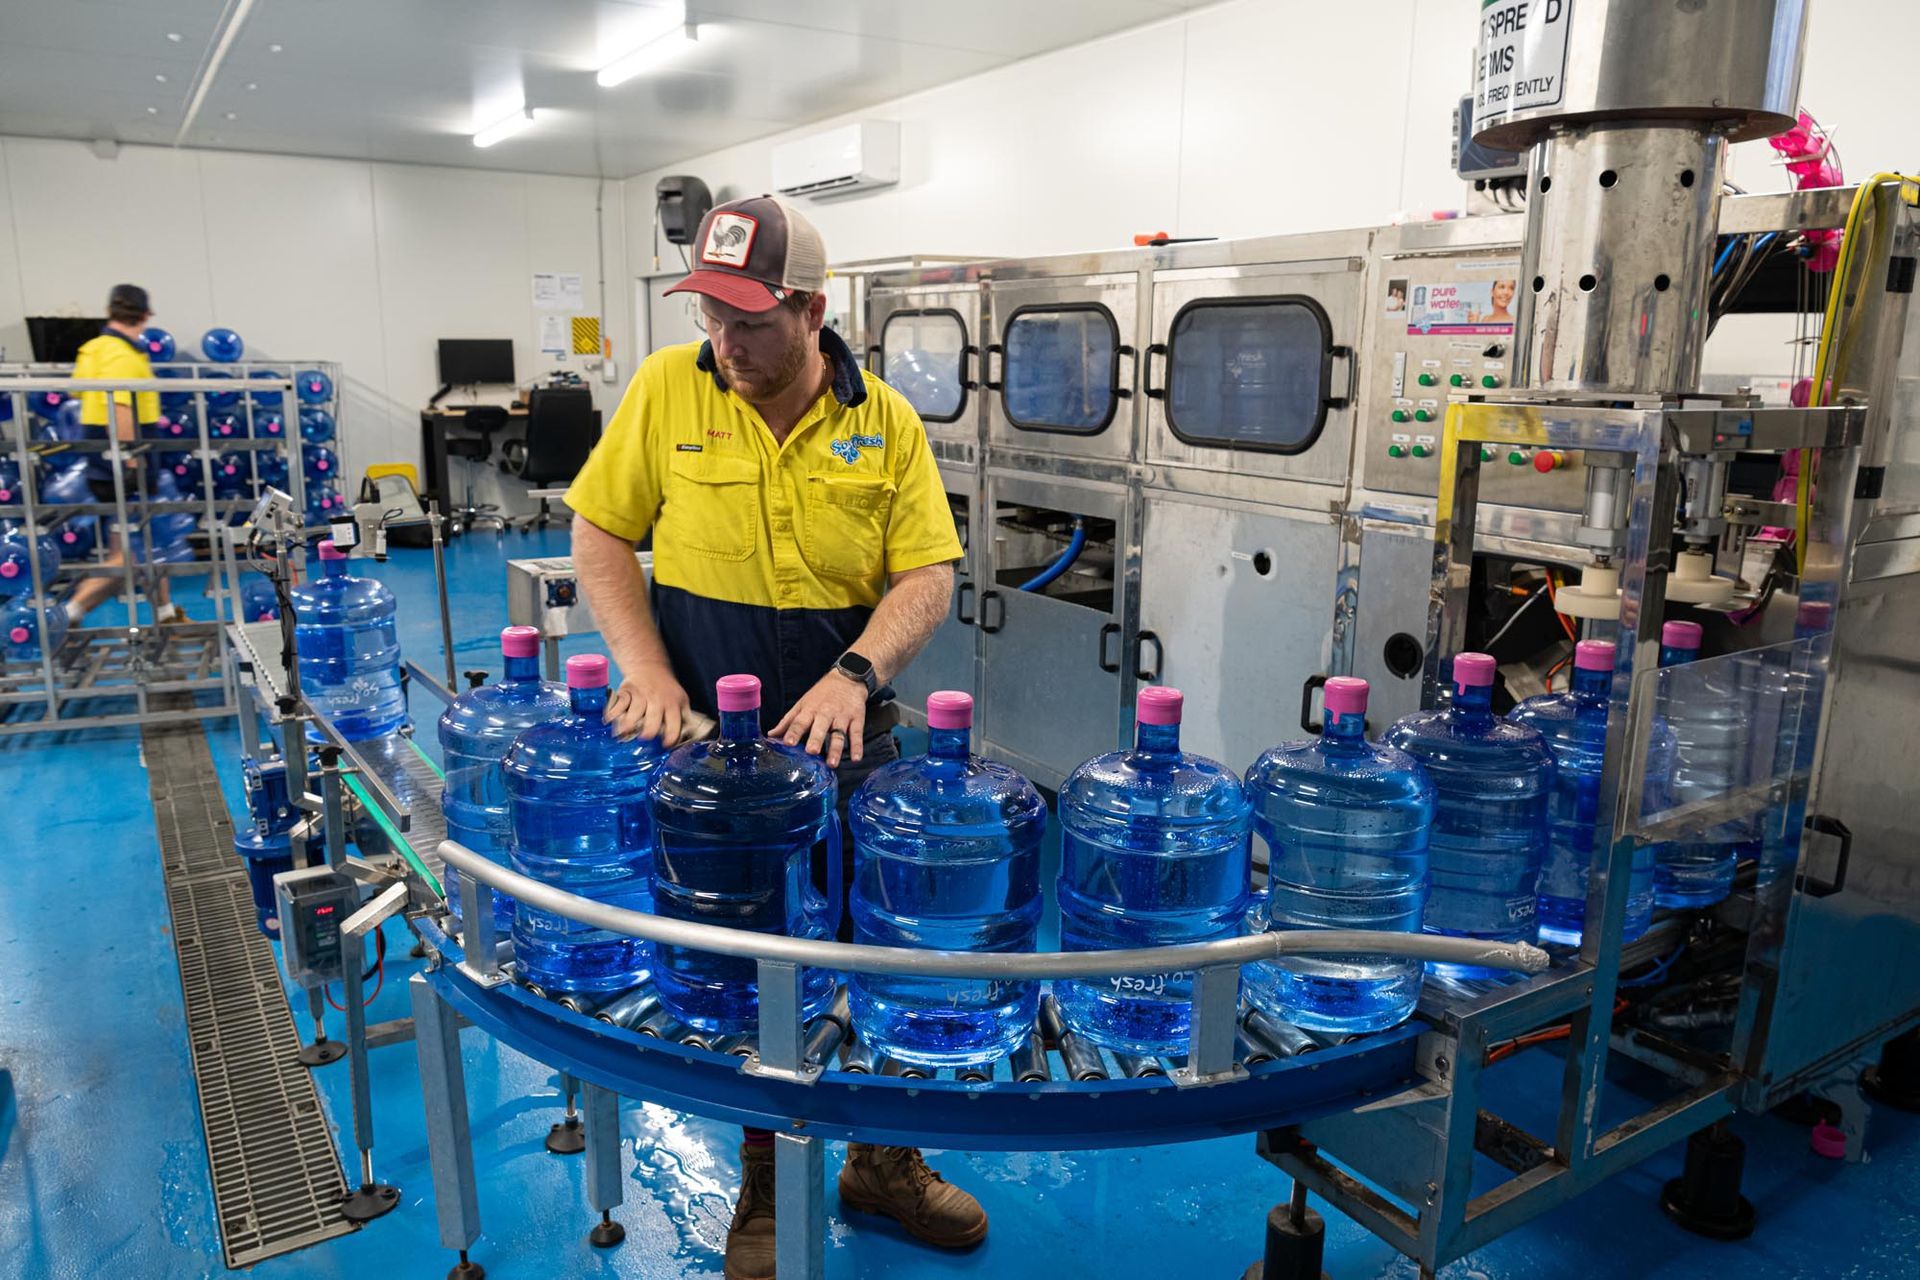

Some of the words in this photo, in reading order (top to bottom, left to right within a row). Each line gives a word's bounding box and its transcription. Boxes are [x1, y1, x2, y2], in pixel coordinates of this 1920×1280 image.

[1488, 0, 1562, 38] SPRED
[1431, 287, 1456, 298] pure
[1430, 300, 1461, 310] water
[707, 428, 732, 440] MATT
[1509, 904, 1536, 921] resh
[1110, 974, 1166, 995] fresh
[946, 978, 1000, 1009] fresh
